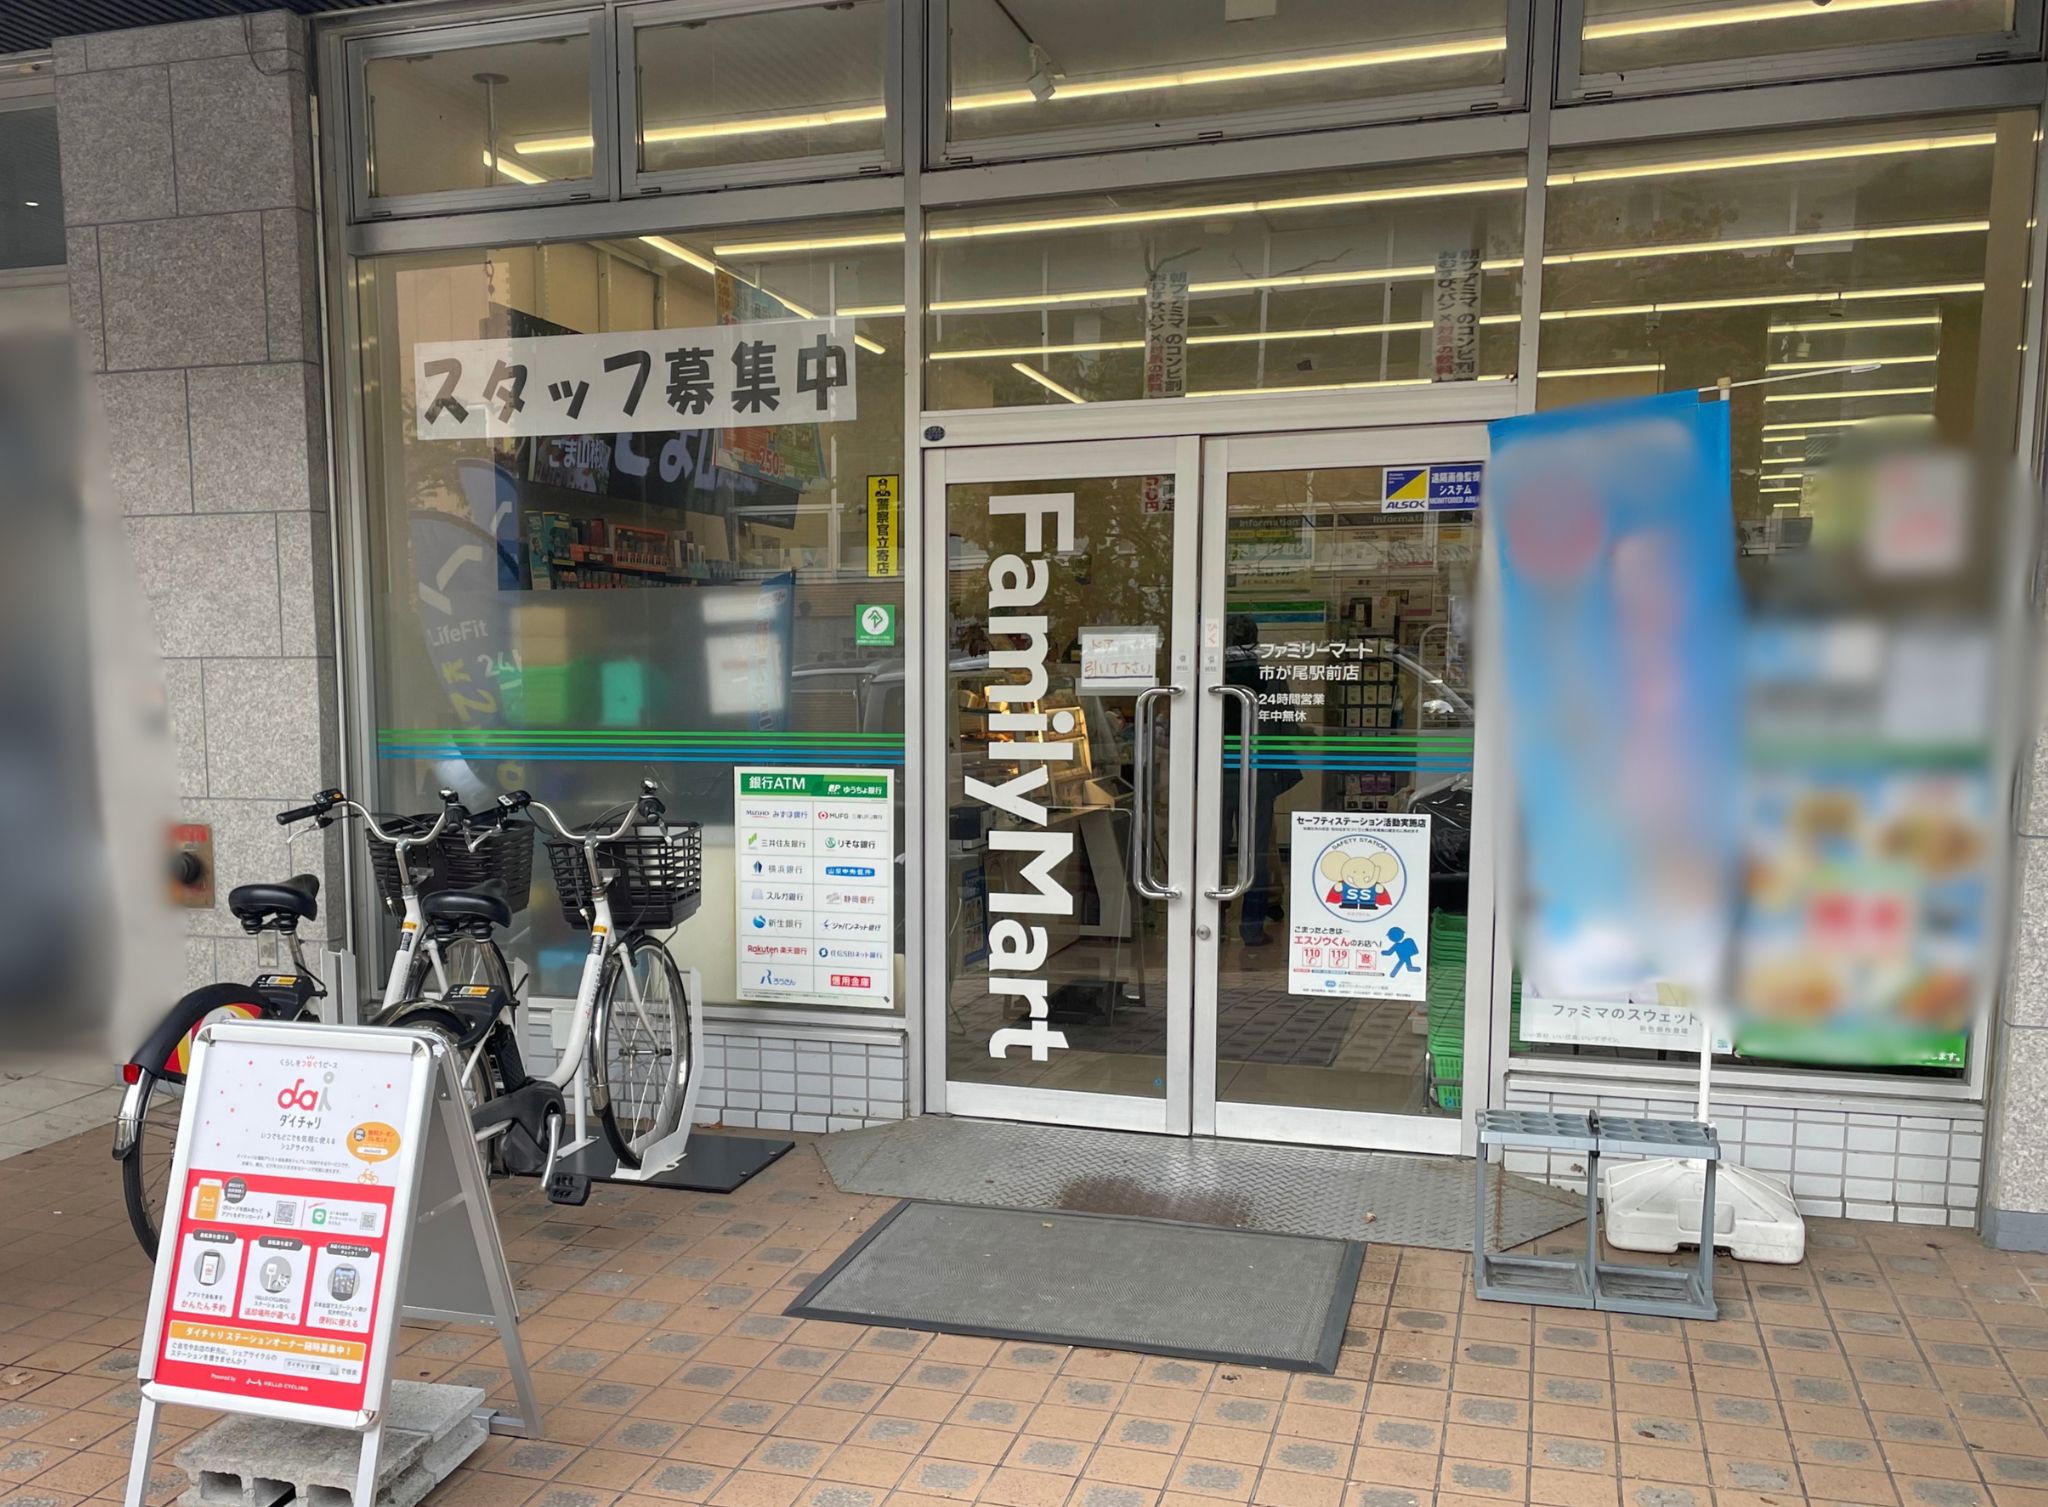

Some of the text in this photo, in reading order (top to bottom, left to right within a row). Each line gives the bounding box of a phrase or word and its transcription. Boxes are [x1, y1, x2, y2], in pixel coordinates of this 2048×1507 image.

[423, 333, 848, 425] スタッフ募集中
[1440, 484, 1472, 495] システム
[1385, 500, 1425, 510] ALSOK
[1373, 513, 1435, 523] Information
[876, 498, 889, 574] 警察官立寄店
[428, 619, 488, 647] LifeFit
[1259, 642, 1373, 659] ファミリーマート
[1085, 661, 1151, 677] 引いて下さい
[1259, 665, 1360, 680] 市が尾駅前店
[1258, 693, 1325, 706] 24時間営業
[1258, 710, 1307, 722] 年中無休
[748, 776, 806, 790] 銀行ATM
[964, 492, 1074, 1062] FamilyMart
[843, 786, 882, 795] ゆうちょ銀行
[772, 810, 808, 819] みずほ銀行
[1296, 816, 1426, 828] セーフティステーション活動実施店
[761, 839, 806, 848] 三井住友銀行
[838, 840, 876, 849] りそな銀行
[1332, 838, 1388, 851] SAFETY STATION
[768, 865, 803, 874] 横浜銀行
[766, 891, 804, 901] スルガ銀行
[844, 895, 875, 905] 静岡銀行
[768, 919, 802, 929] 新生銀行
[832, 923, 881, 932] ジャパンネット銀行
[747, 944, 807, 955] Rakuten 楽天銀行
[830, 950, 882, 959] 住信SBIネット銀行
[1304, 948, 1320, 958] 110
[1331, 950, 1347, 959] 119
[832, 975, 870, 988] 信用金庫
[280, 1114, 322, 1129] ダイチャリ
[260, 1132, 336, 1145] いつでもどこでも気軽に使える
[280, 1143, 315, 1152] シェアサイクル
[180, 1300, 226, 1313] かんたん予約
[244, 1307, 296, 1321] 返却場所が選べる
[319, 1316, 358, 1328] 便利に使える
[186, 1327, 224, 1339] ダイチャリ
[283, 1383, 309, 1392] CYCLING
